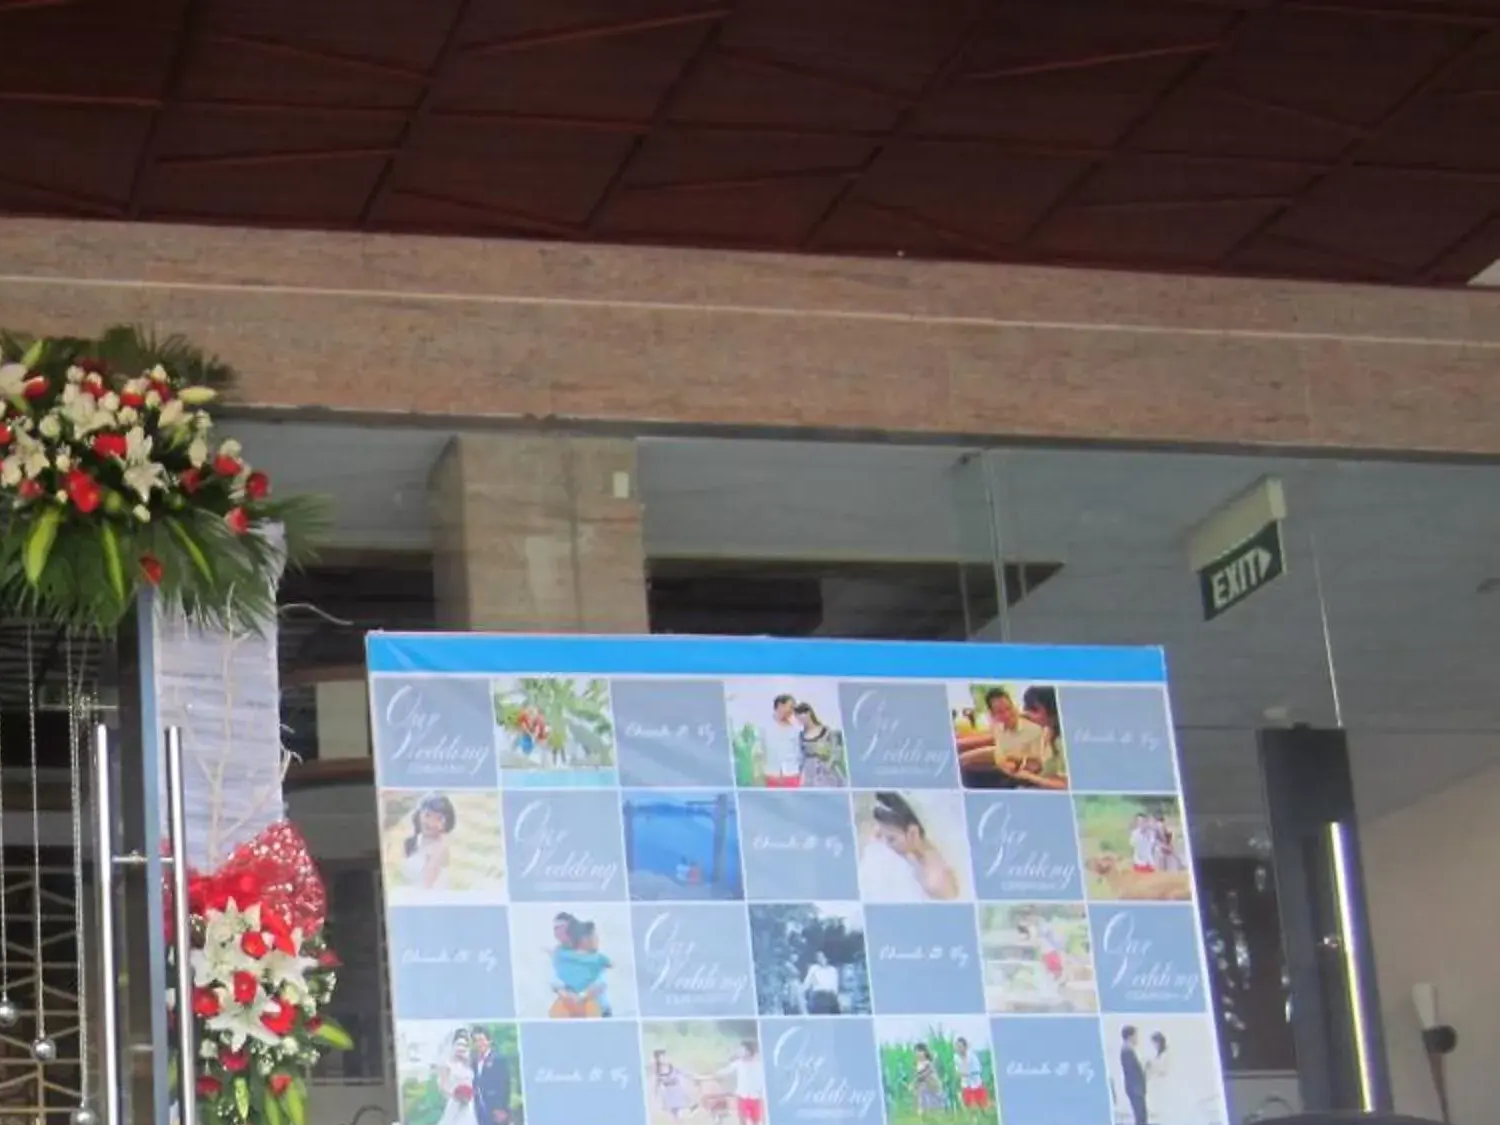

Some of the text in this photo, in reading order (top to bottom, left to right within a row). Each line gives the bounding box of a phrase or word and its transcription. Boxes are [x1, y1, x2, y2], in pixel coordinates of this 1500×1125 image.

[1211, 547, 1258, 609] EXIT
[384, 684, 441, 729] Our
[851, 689, 903, 732] Our
[390, 727, 491, 775] Wedding
[859, 730, 951, 778] Wedding
[513, 800, 569, 845] Our
[977, 802, 1029, 846] Our
[519, 844, 619, 892] Wedding
[985, 844, 1077, 891] Wedding
[643, 911, 699, 957] Our
[1102, 911, 1153, 955] Our
[649, 956, 749, 1004] Wedding
[1109, 954, 1200, 1002] Wedding
[772, 1025, 828, 1071] Our
[779, 1070, 878, 1119] Wedding
